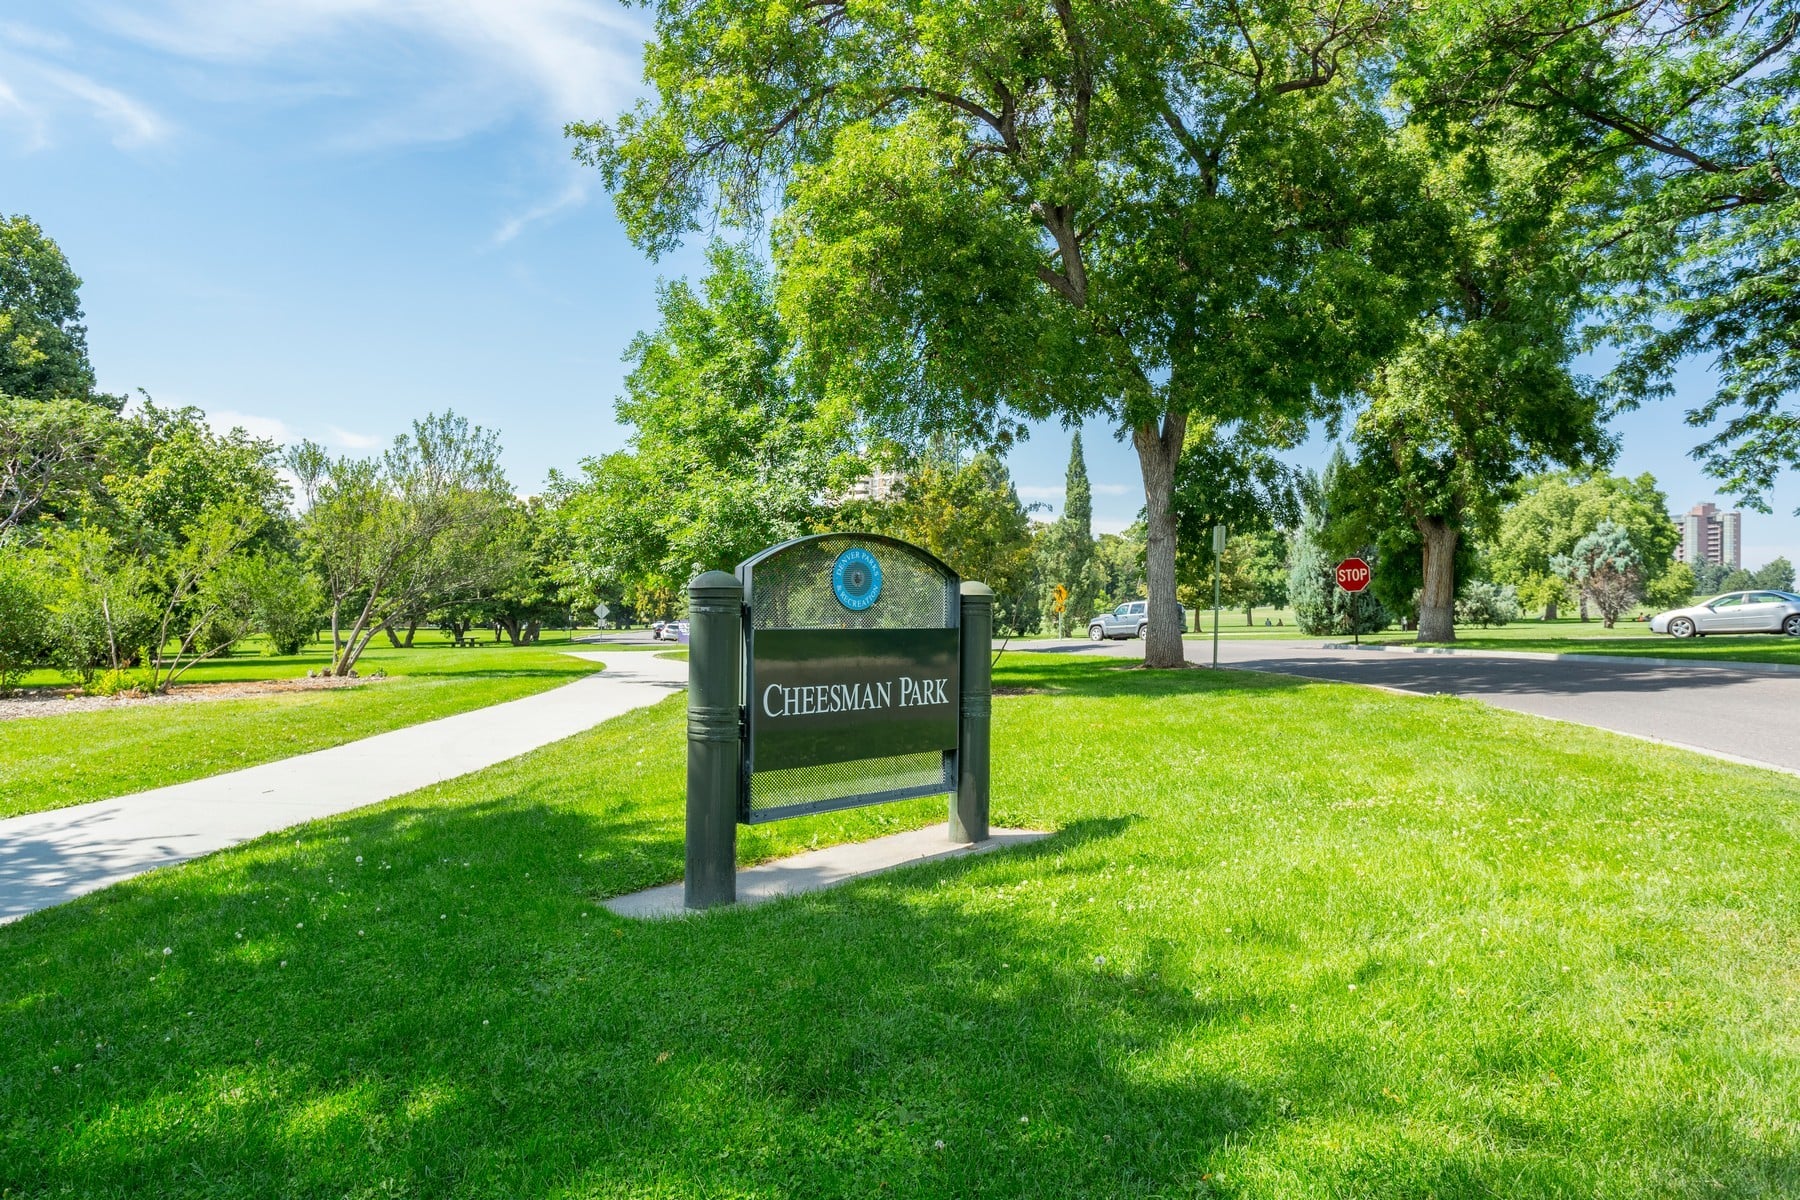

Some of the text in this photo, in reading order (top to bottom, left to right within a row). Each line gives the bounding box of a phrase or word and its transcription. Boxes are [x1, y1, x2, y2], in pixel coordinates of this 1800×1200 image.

[836, 551, 879, 577] DENVER PARKS
[1338, 568, 1368, 582] STOP
[840, 585, 879, 608] RECREATION
[763, 677, 949, 717] CHEESMAN PARK
